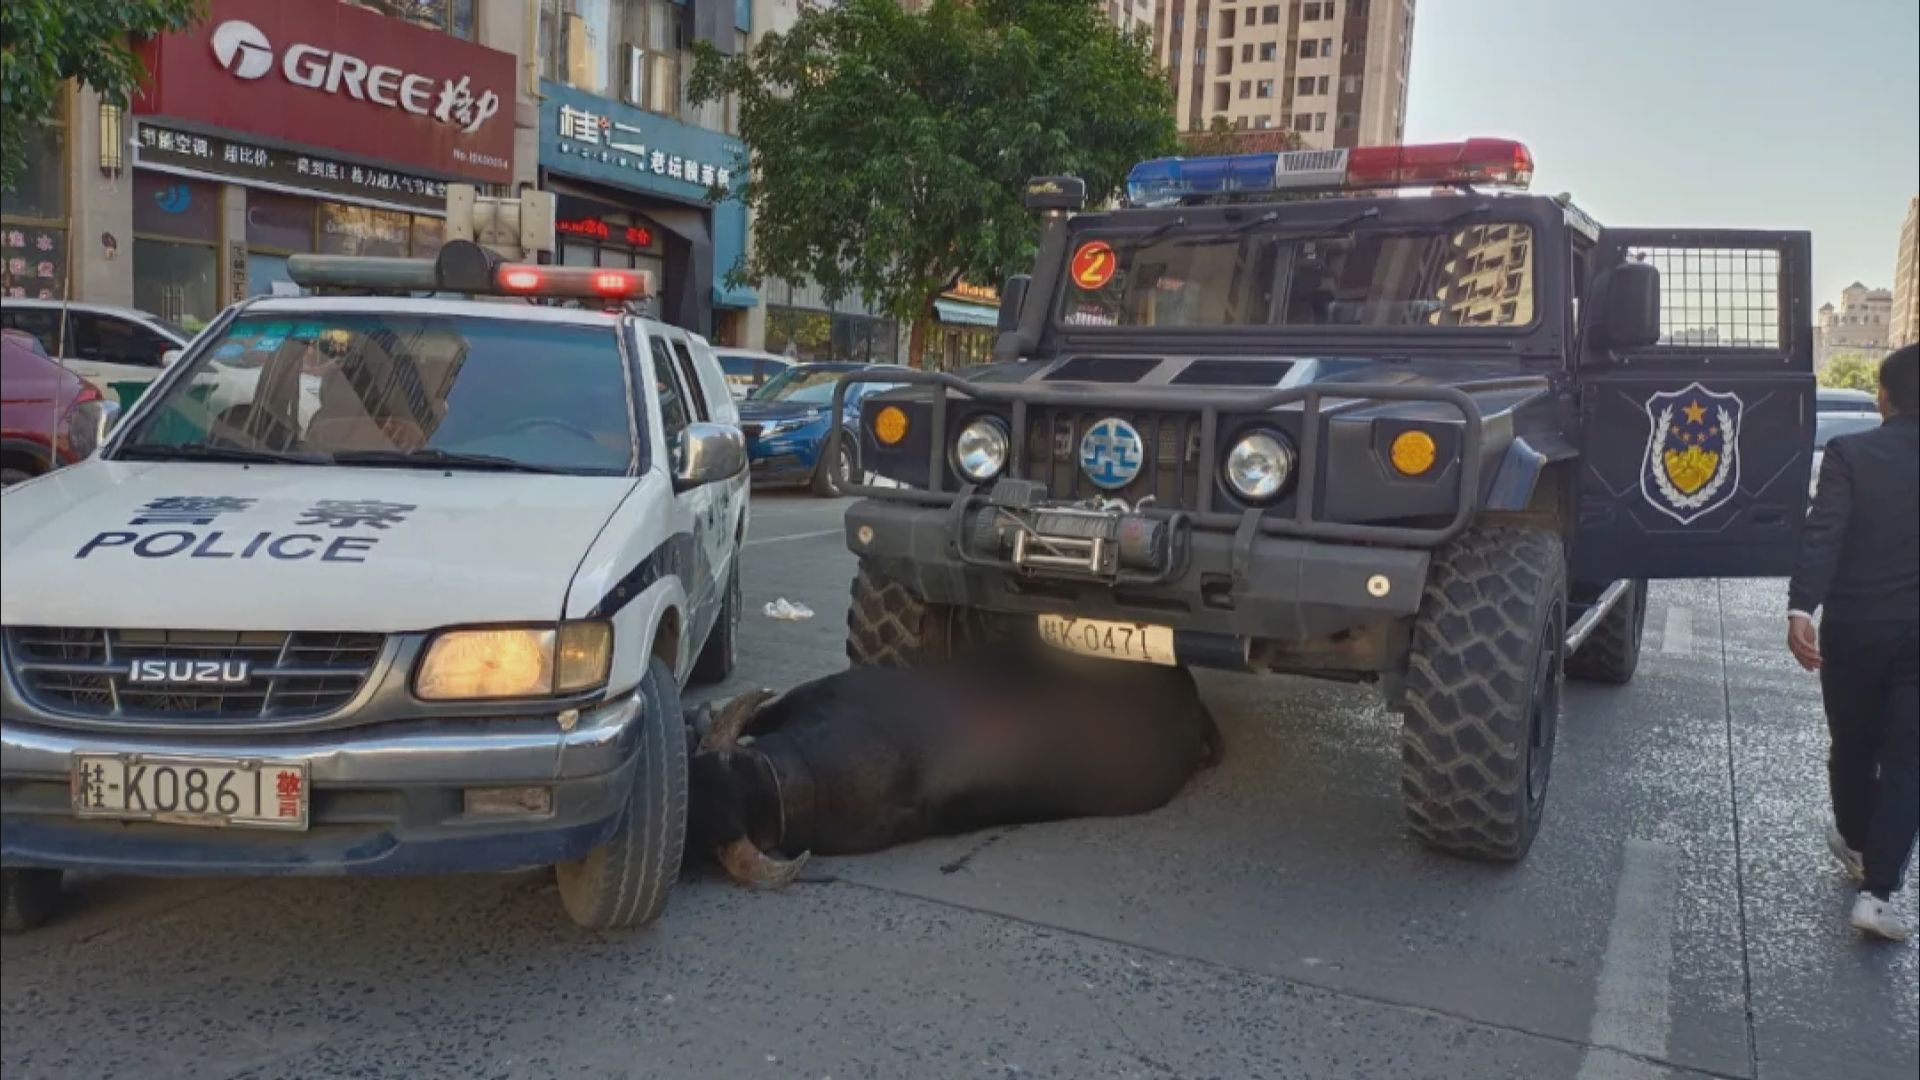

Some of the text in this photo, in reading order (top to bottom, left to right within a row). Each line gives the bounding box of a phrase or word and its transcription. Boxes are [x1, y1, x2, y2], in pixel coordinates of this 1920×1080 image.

[283, 43, 499, 133] GREE 格力
[1080, 248, 1105, 282] 2
[74, 531, 380, 563] POLICE
[131, 660, 247, 681] ISUZU
